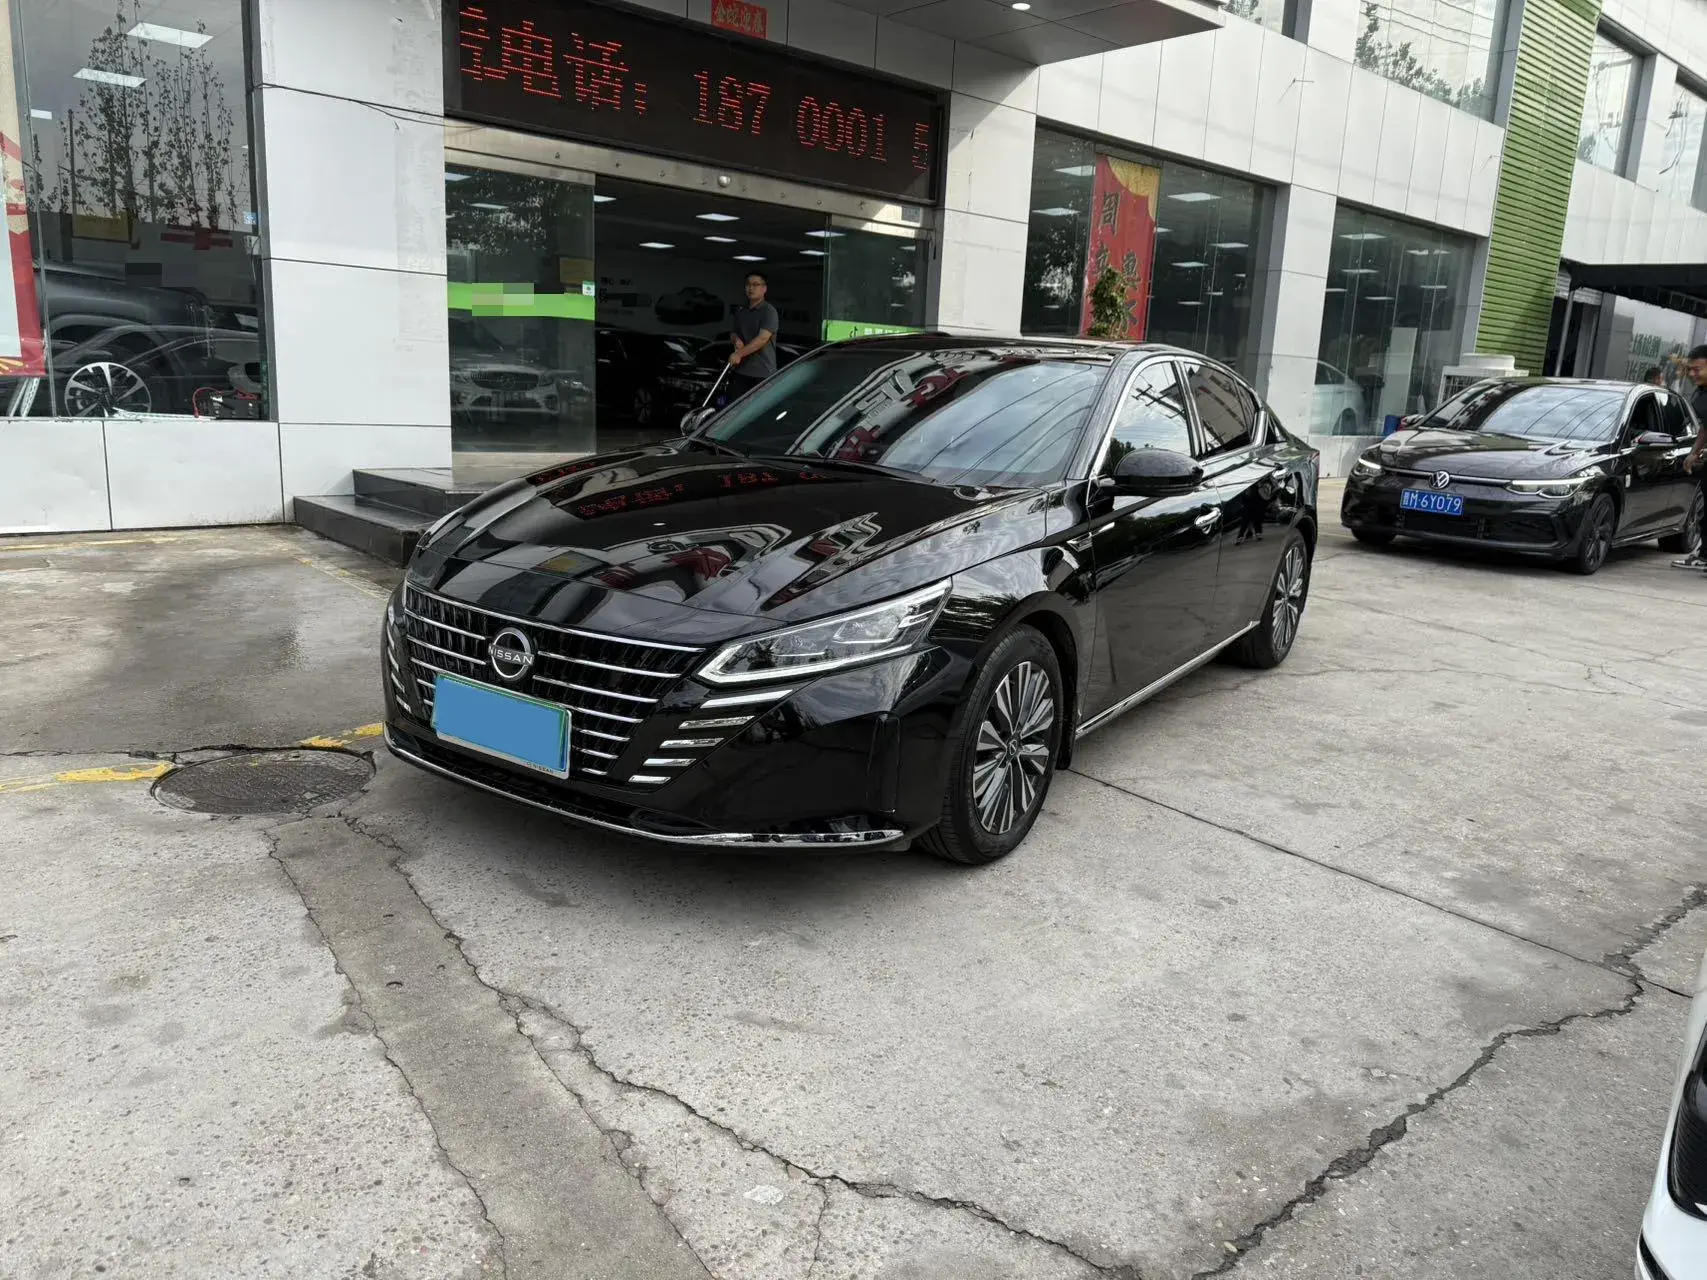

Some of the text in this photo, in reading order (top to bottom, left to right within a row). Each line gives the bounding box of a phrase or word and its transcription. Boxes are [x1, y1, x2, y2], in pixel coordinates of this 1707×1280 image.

[693, 70, 771, 135] 187
[797, 95, 887, 161] 0001
[488, 643, 533, 665] NISSAN
